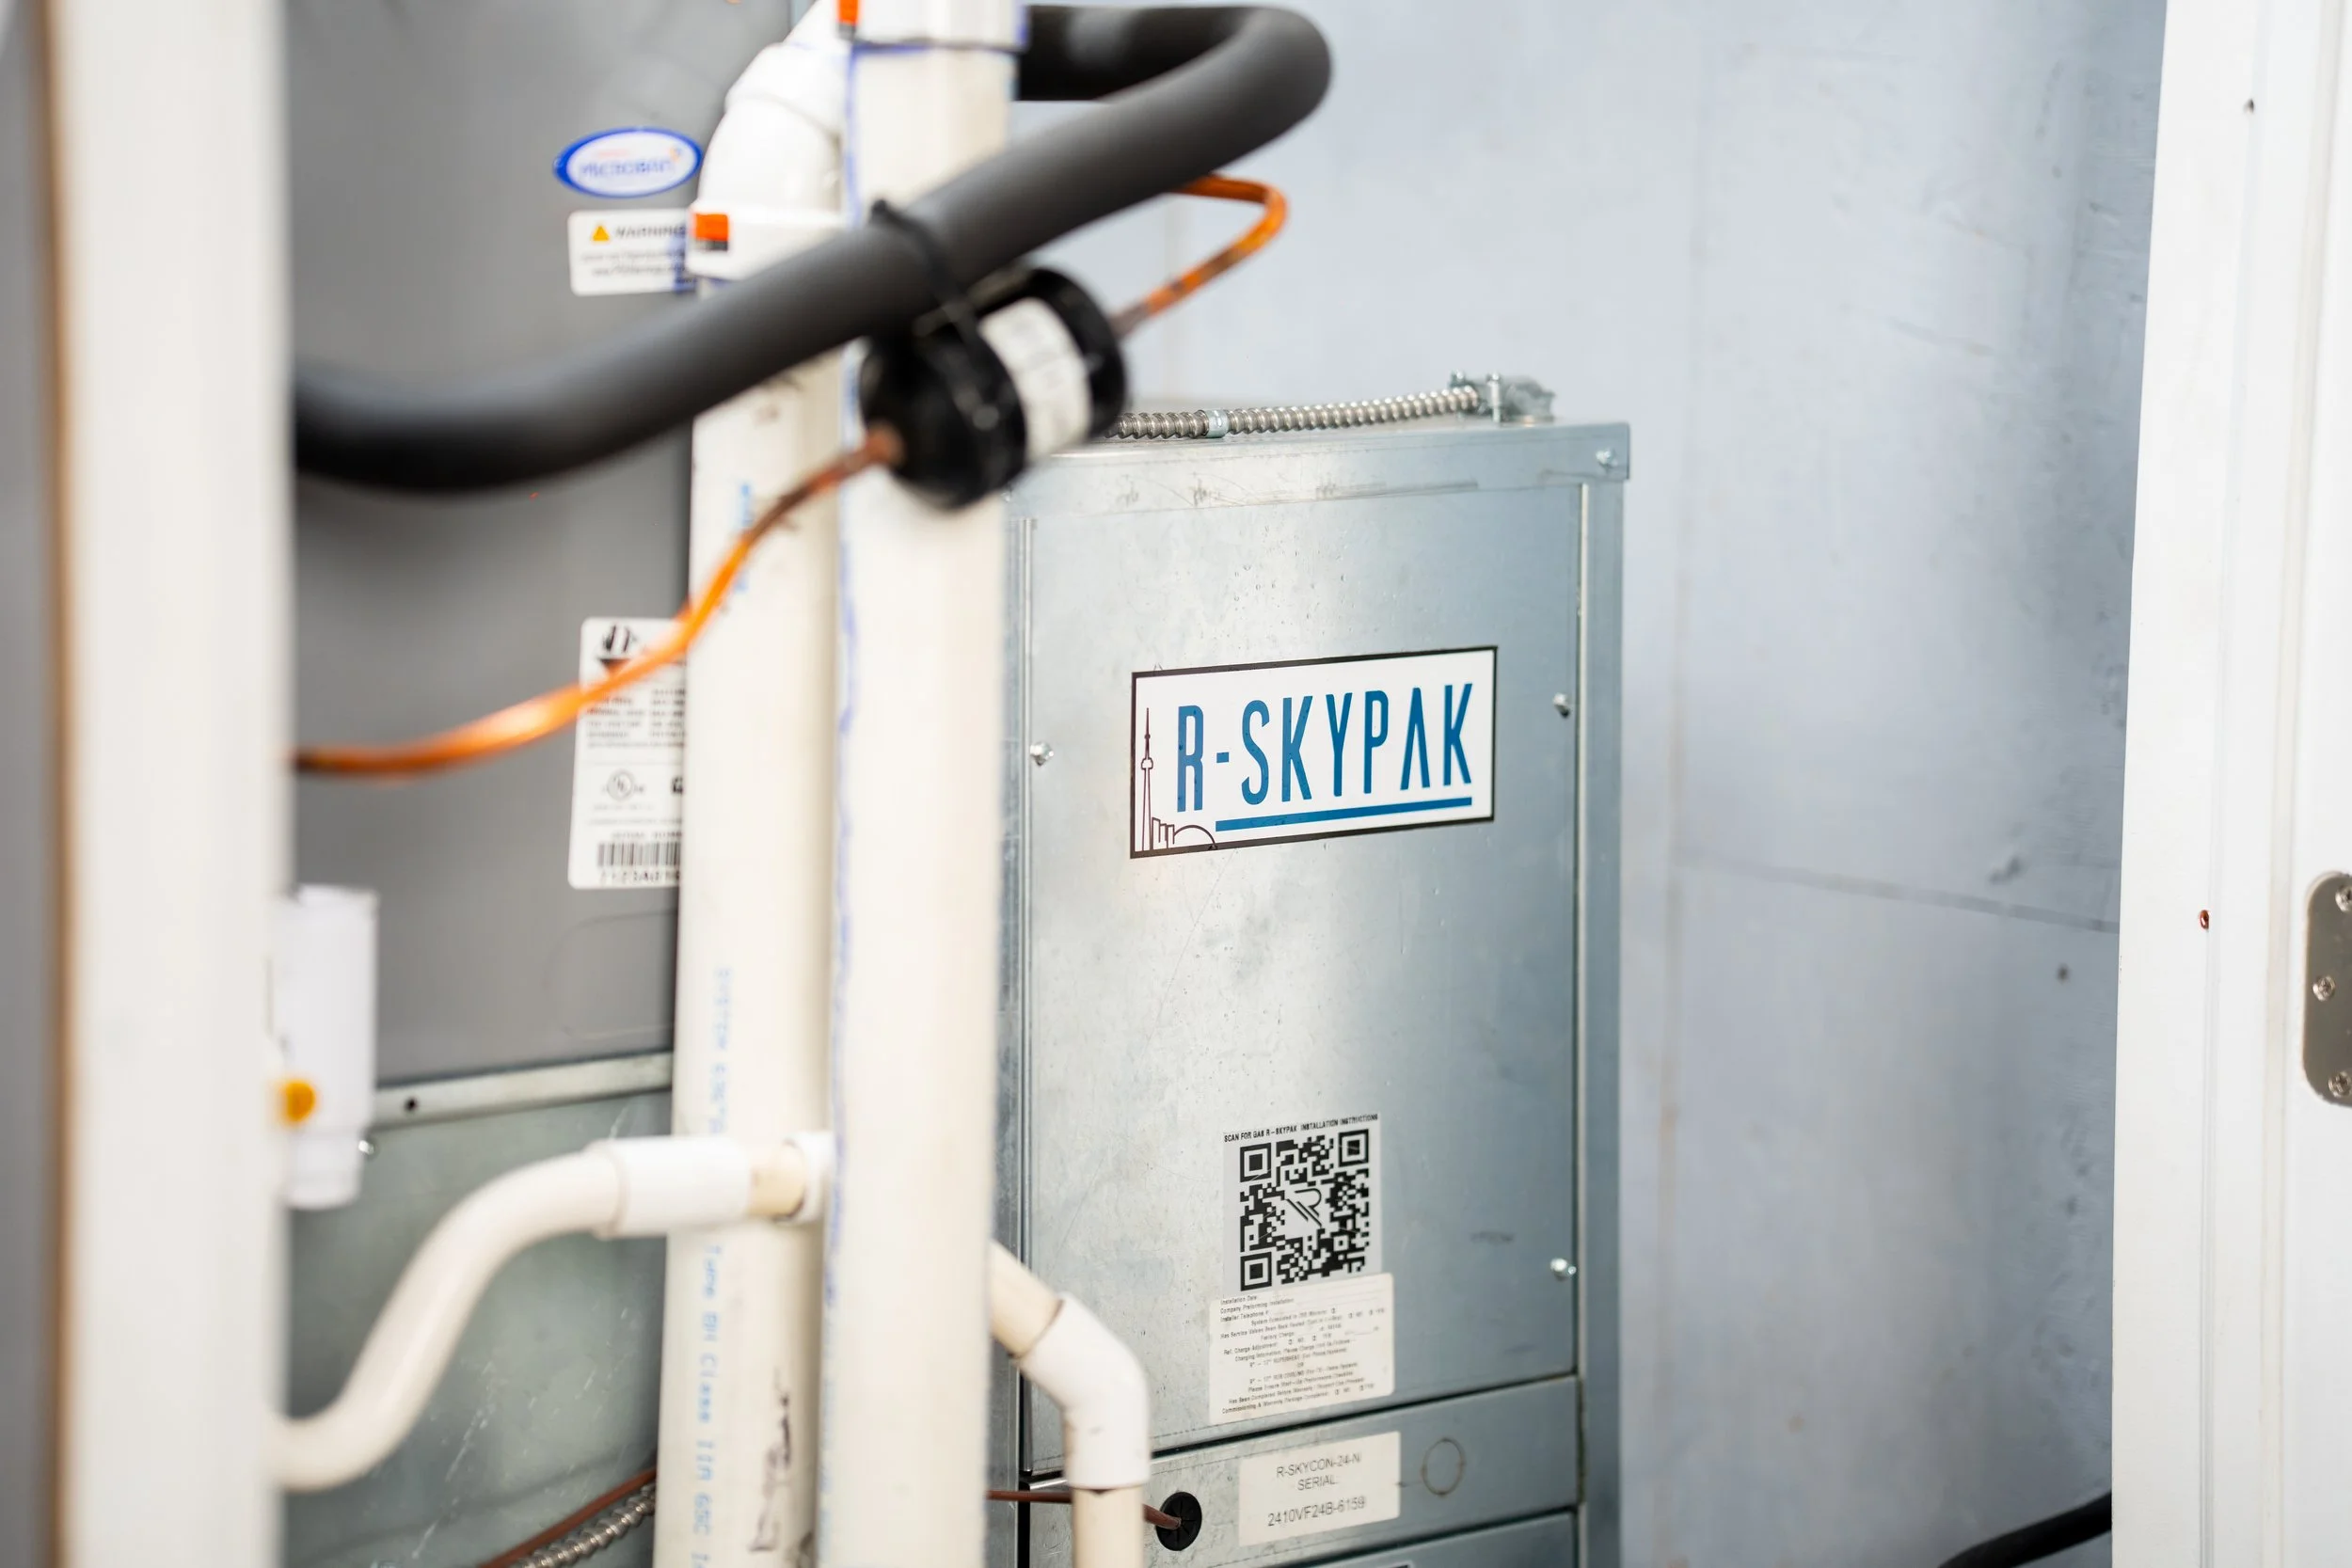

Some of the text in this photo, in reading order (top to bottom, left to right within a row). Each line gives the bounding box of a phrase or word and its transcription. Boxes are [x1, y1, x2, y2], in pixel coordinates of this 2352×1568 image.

[1176, 683, 1472, 813] R-SKYPAK
[1224, 1133, 1239, 1142] SCAN
[1241, 1132, 1252, 1140] FOR
[1253, 1130, 1264, 1138] GAS
[1301, 1119, 1338, 1132] INSTALLATION
[1340, 1114, 1378, 1125] INSTRUCTIONS
[1220, 1307, 1241, 1315] Company
[1276, 1452, 1361, 1478] R-SKYCON-24-N
